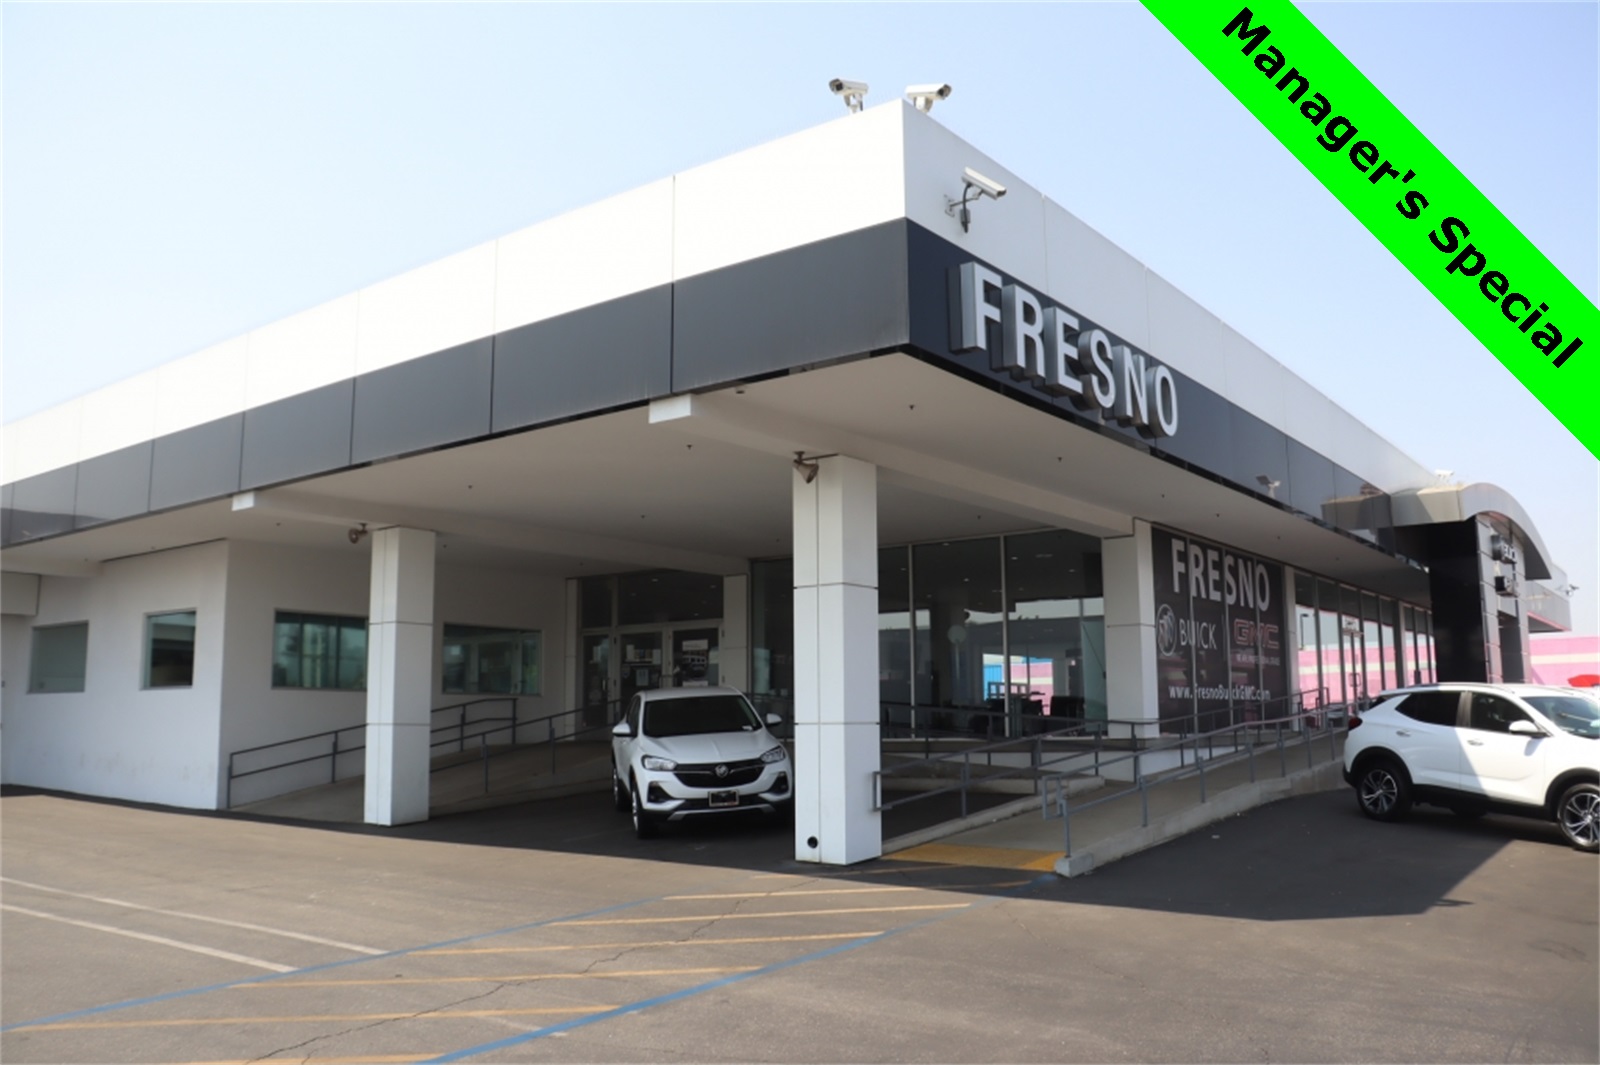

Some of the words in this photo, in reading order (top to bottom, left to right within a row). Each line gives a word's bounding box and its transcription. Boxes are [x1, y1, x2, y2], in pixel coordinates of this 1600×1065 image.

[960, 261, 1178, 437] FRESNO
[1171, 537, 1270, 612] FRESNO
[1179, 618, 1217, 650] BUICK
[1234, 618, 1279, 649] GMC
[1168, 683, 1271, 700] www.resnoBuckGMC.cm
